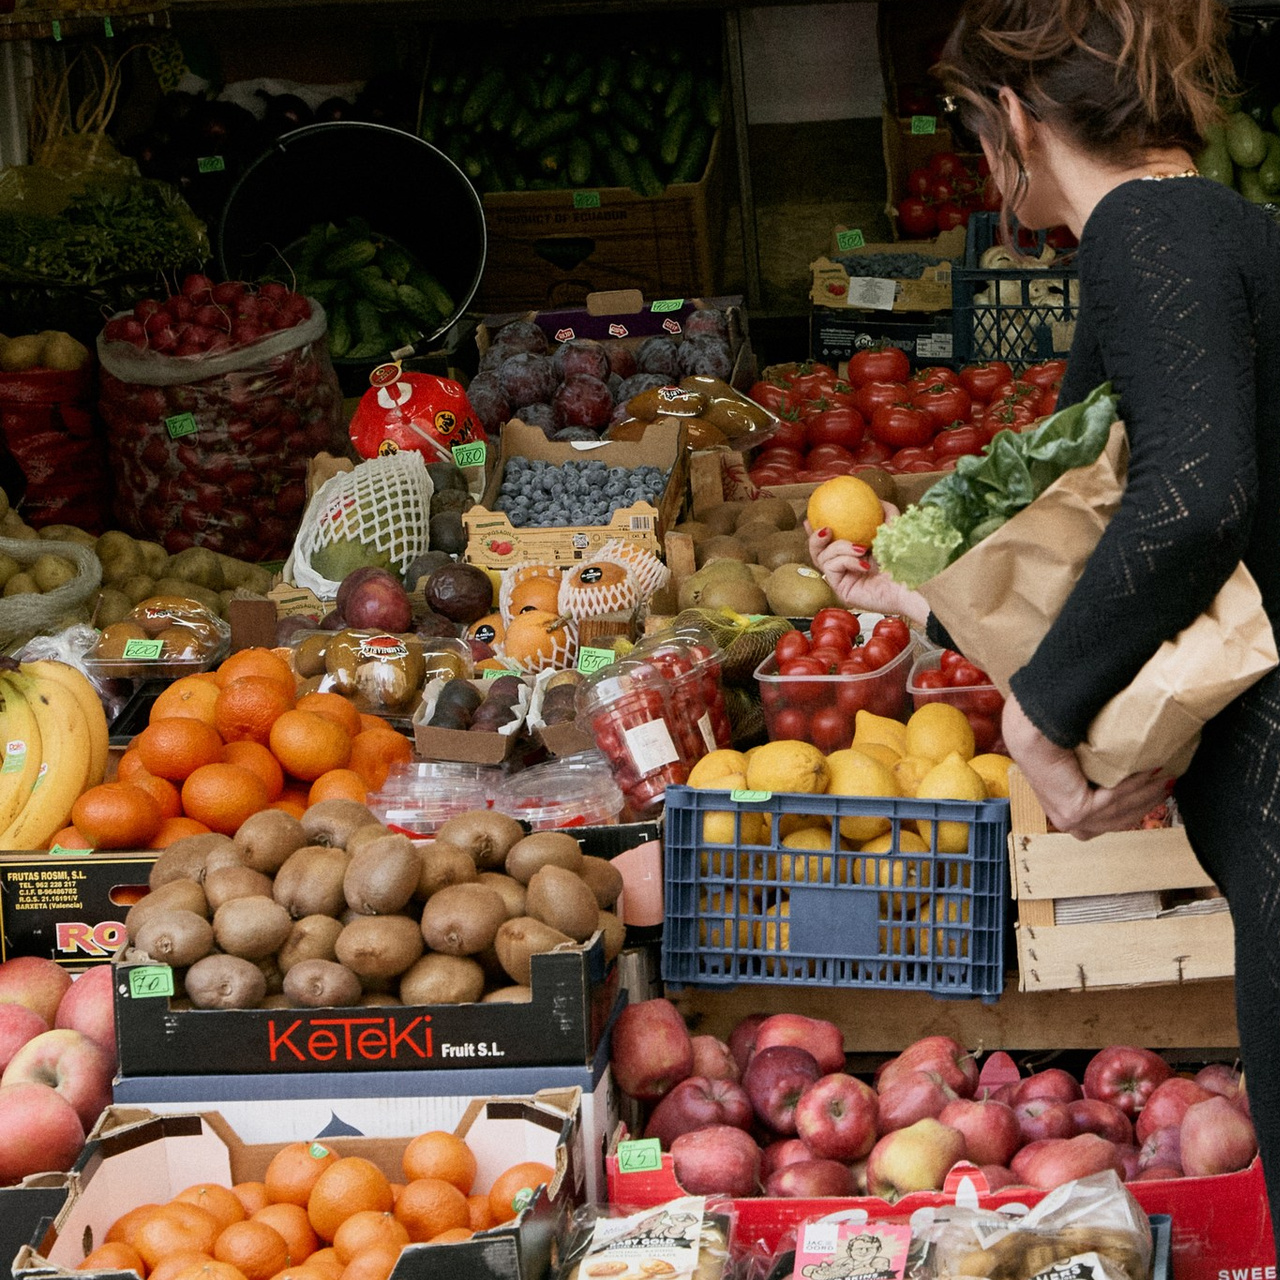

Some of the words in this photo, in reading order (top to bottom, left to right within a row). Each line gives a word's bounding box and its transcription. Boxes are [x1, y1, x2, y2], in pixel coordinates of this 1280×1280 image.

[7, 871, 39, 882] FRUTAS
[40, 871, 70, 882] ROSMI,
[72, 870, 87, 880] S.L.
[15, 902, 46, 910] BARXETA
[47, 901, 84, 910] (Valencia)
[441, 1042, 475, 1059] Fruit
[477, 1041, 505, 1058] S.L.
[641, 1236, 676, 1247] GOLD
